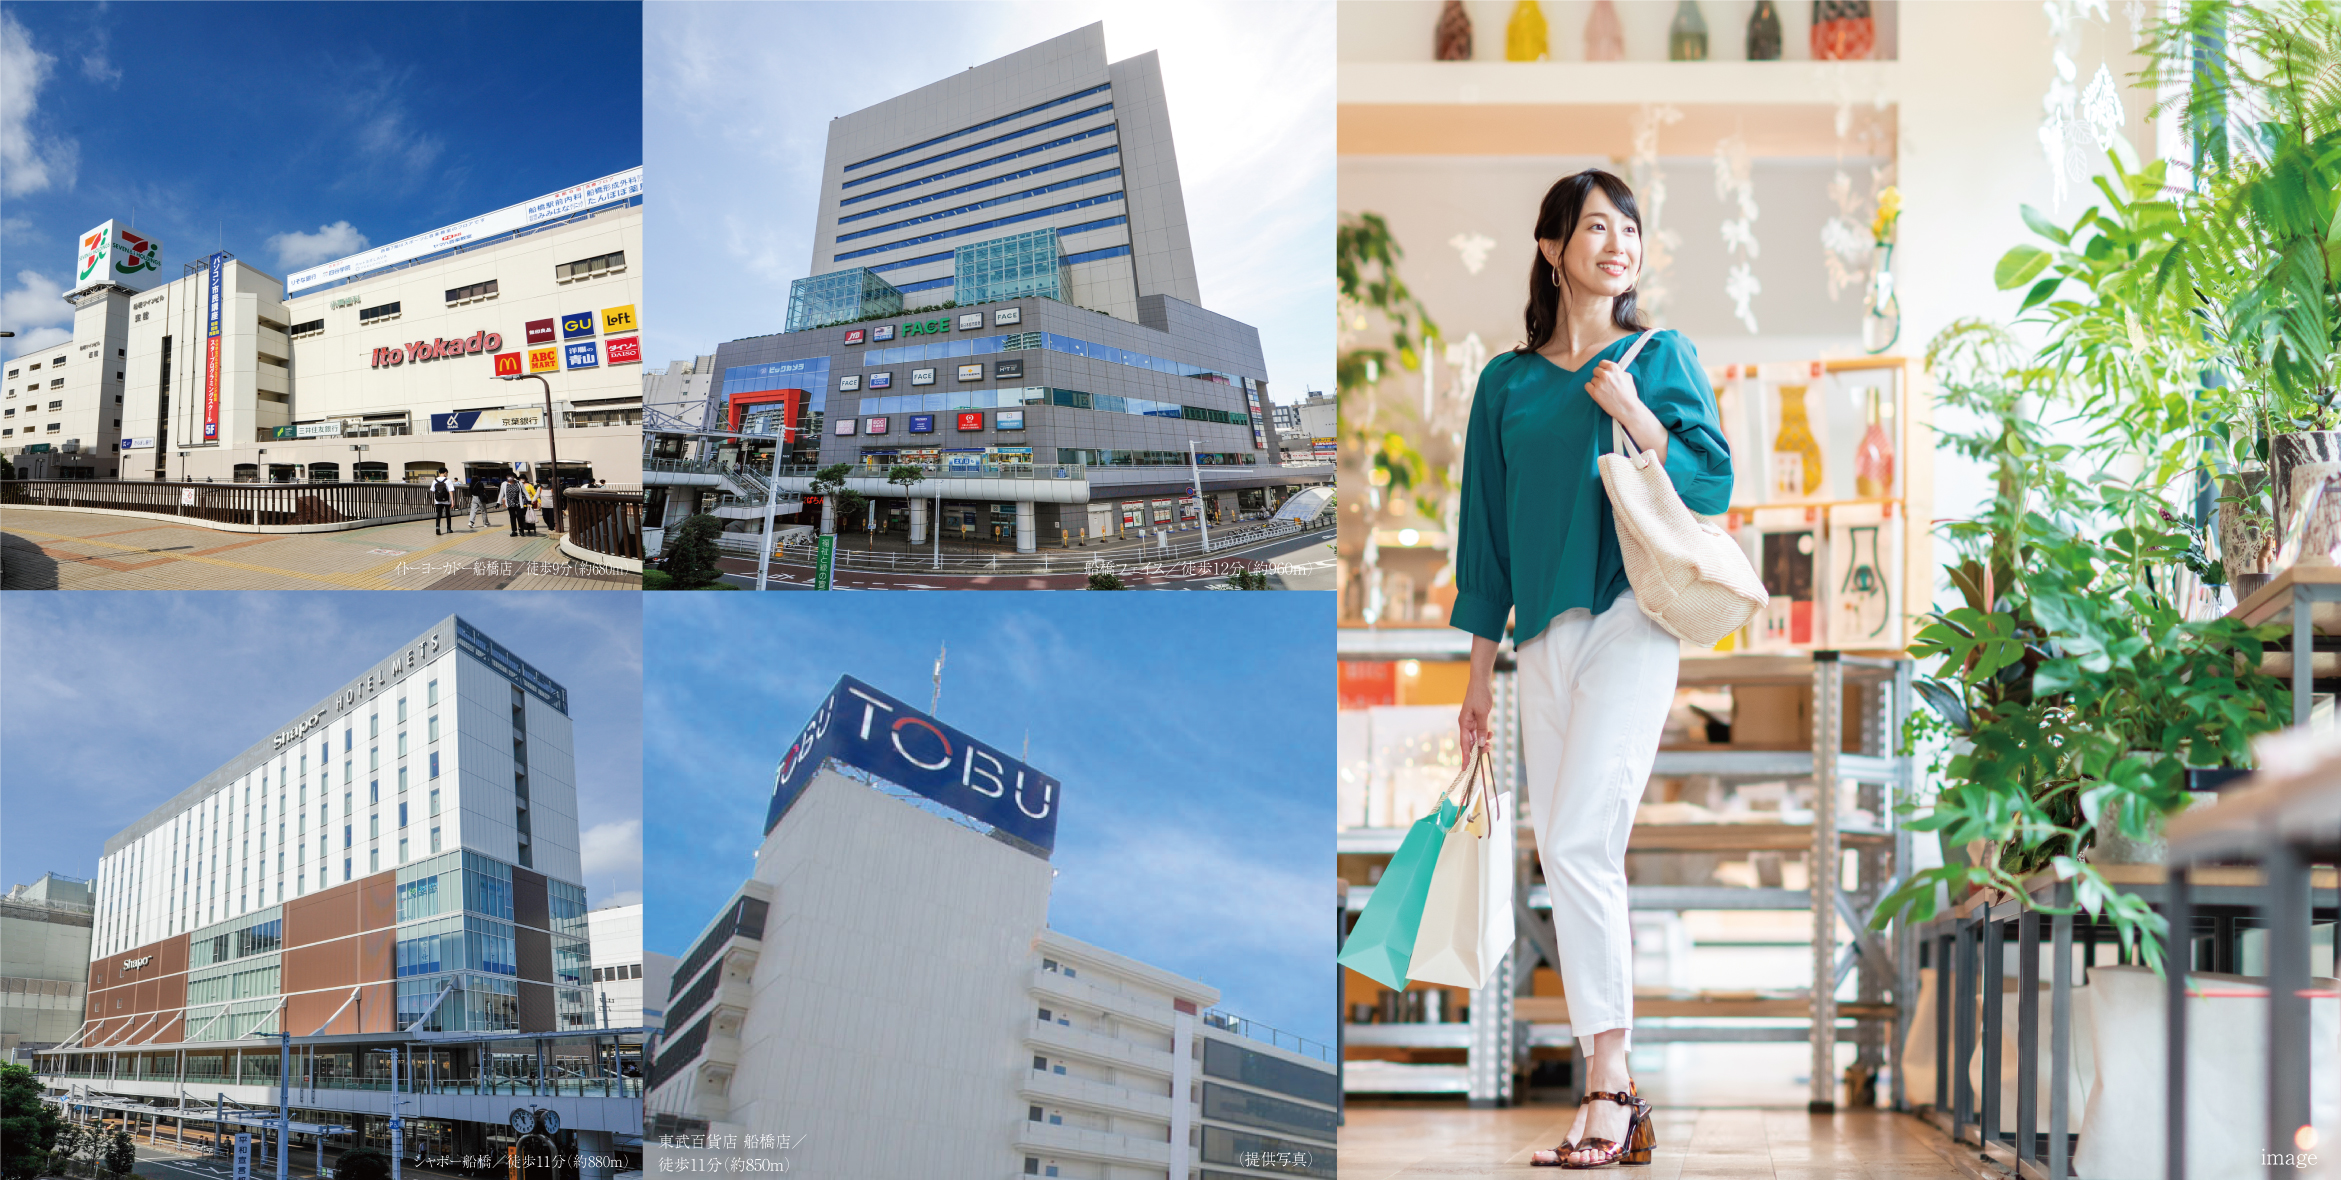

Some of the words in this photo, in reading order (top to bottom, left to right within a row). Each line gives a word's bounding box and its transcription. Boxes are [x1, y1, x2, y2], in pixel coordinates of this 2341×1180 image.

[528, 192, 582, 214] 船橋駅前内科
[291, 273, 317, 286] りそな銀行
[211, 256, 220, 321] パソコン市民講座
[997, 312, 1018, 321] FACE
[565, 318, 592, 332] GU
[902, 317, 951, 337] FACE
[529, 327, 552, 335] 無印良品
[848, 332, 861, 341] JTB
[371, 346, 403, 367] Ito
[404, 330, 503, 362] Yokado
[568, 346, 593, 354] 洋服の
[608, 343, 637, 352] ダイソー
[531, 351, 555, 362] ABC
[610, 350, 637, 358] DAISO
[531, 360, 556, 369] MART
[569, 354, 596, 366] 青山
[769, 363, 805, 374] ビックカメラ
[502, 416, 538, 426] 京葉銀行
[206, 424, 215, 435] 5F
[298, 424, 339, 435] 三井住友銀行
[274, 712, 322, 749] Shapo
[336, 669, 385, 712] HOTEL
[392, 633, 439, 677] METS
[773, 694, 835, 797] TOBU
[849, 687, 1052, 819] TOBU
[123, 957, 150, 971] Shapo
